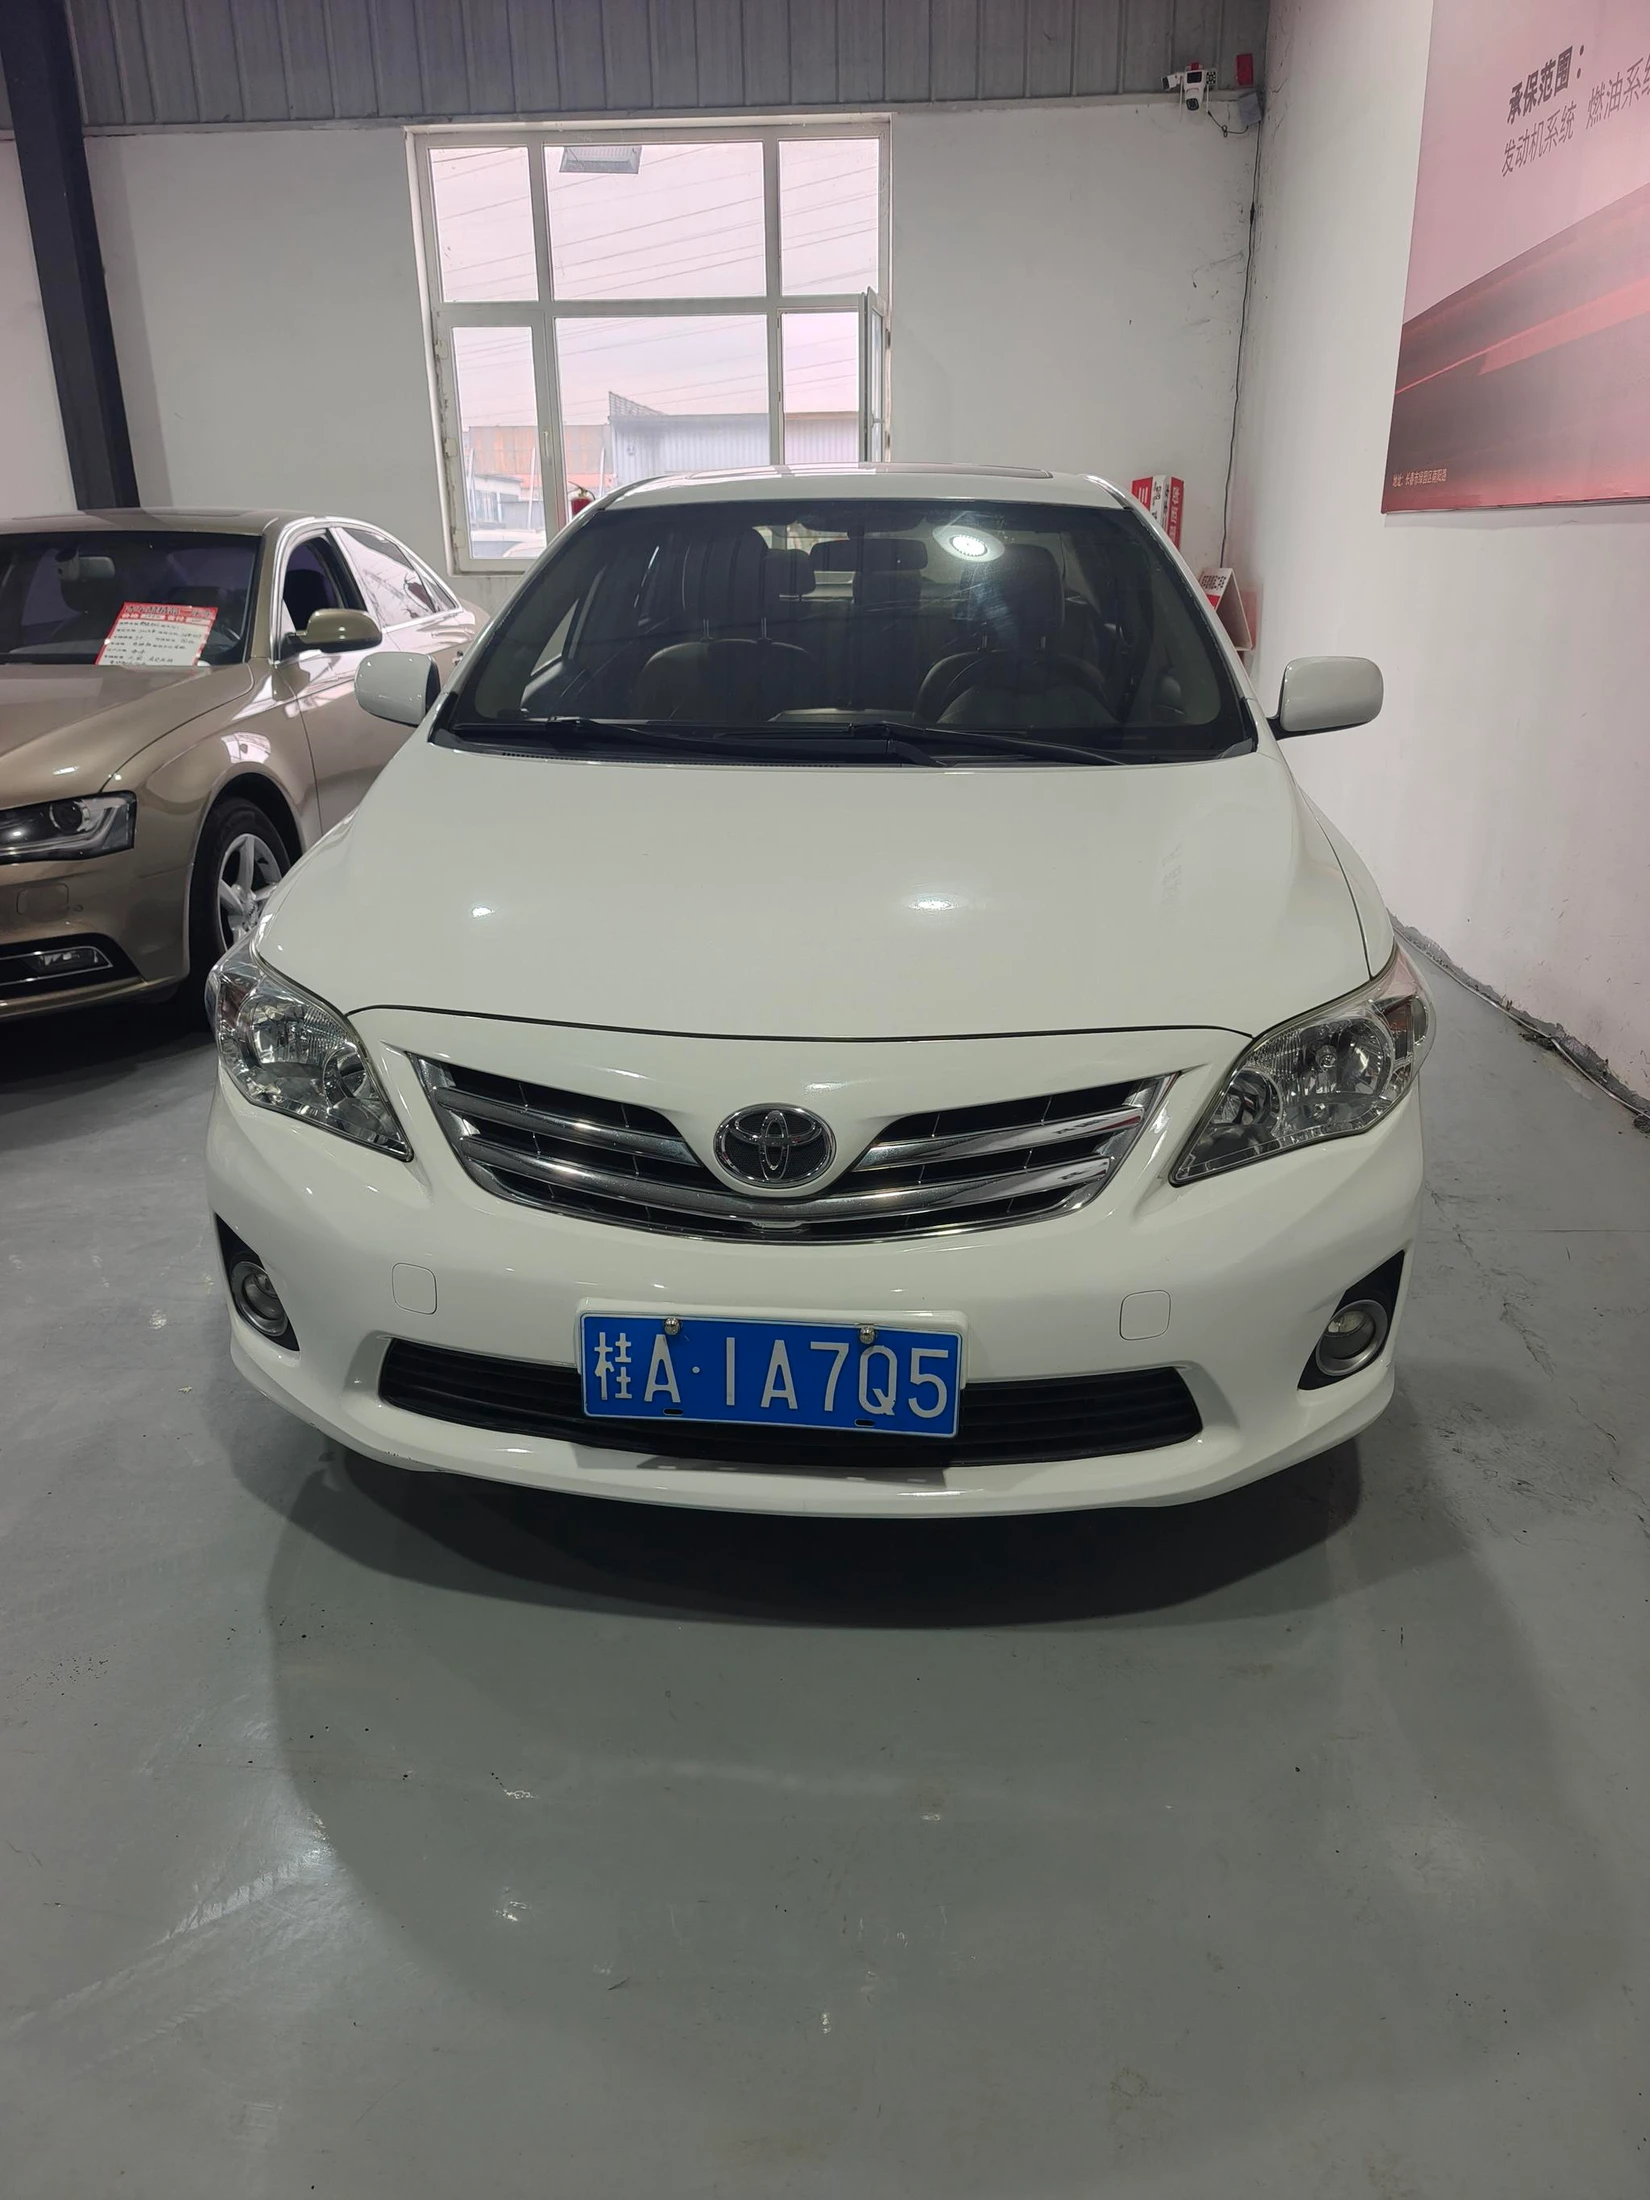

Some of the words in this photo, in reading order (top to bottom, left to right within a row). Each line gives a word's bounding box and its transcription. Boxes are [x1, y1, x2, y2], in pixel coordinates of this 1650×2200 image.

[1501, 100, 1577, 177] 发动机系统
